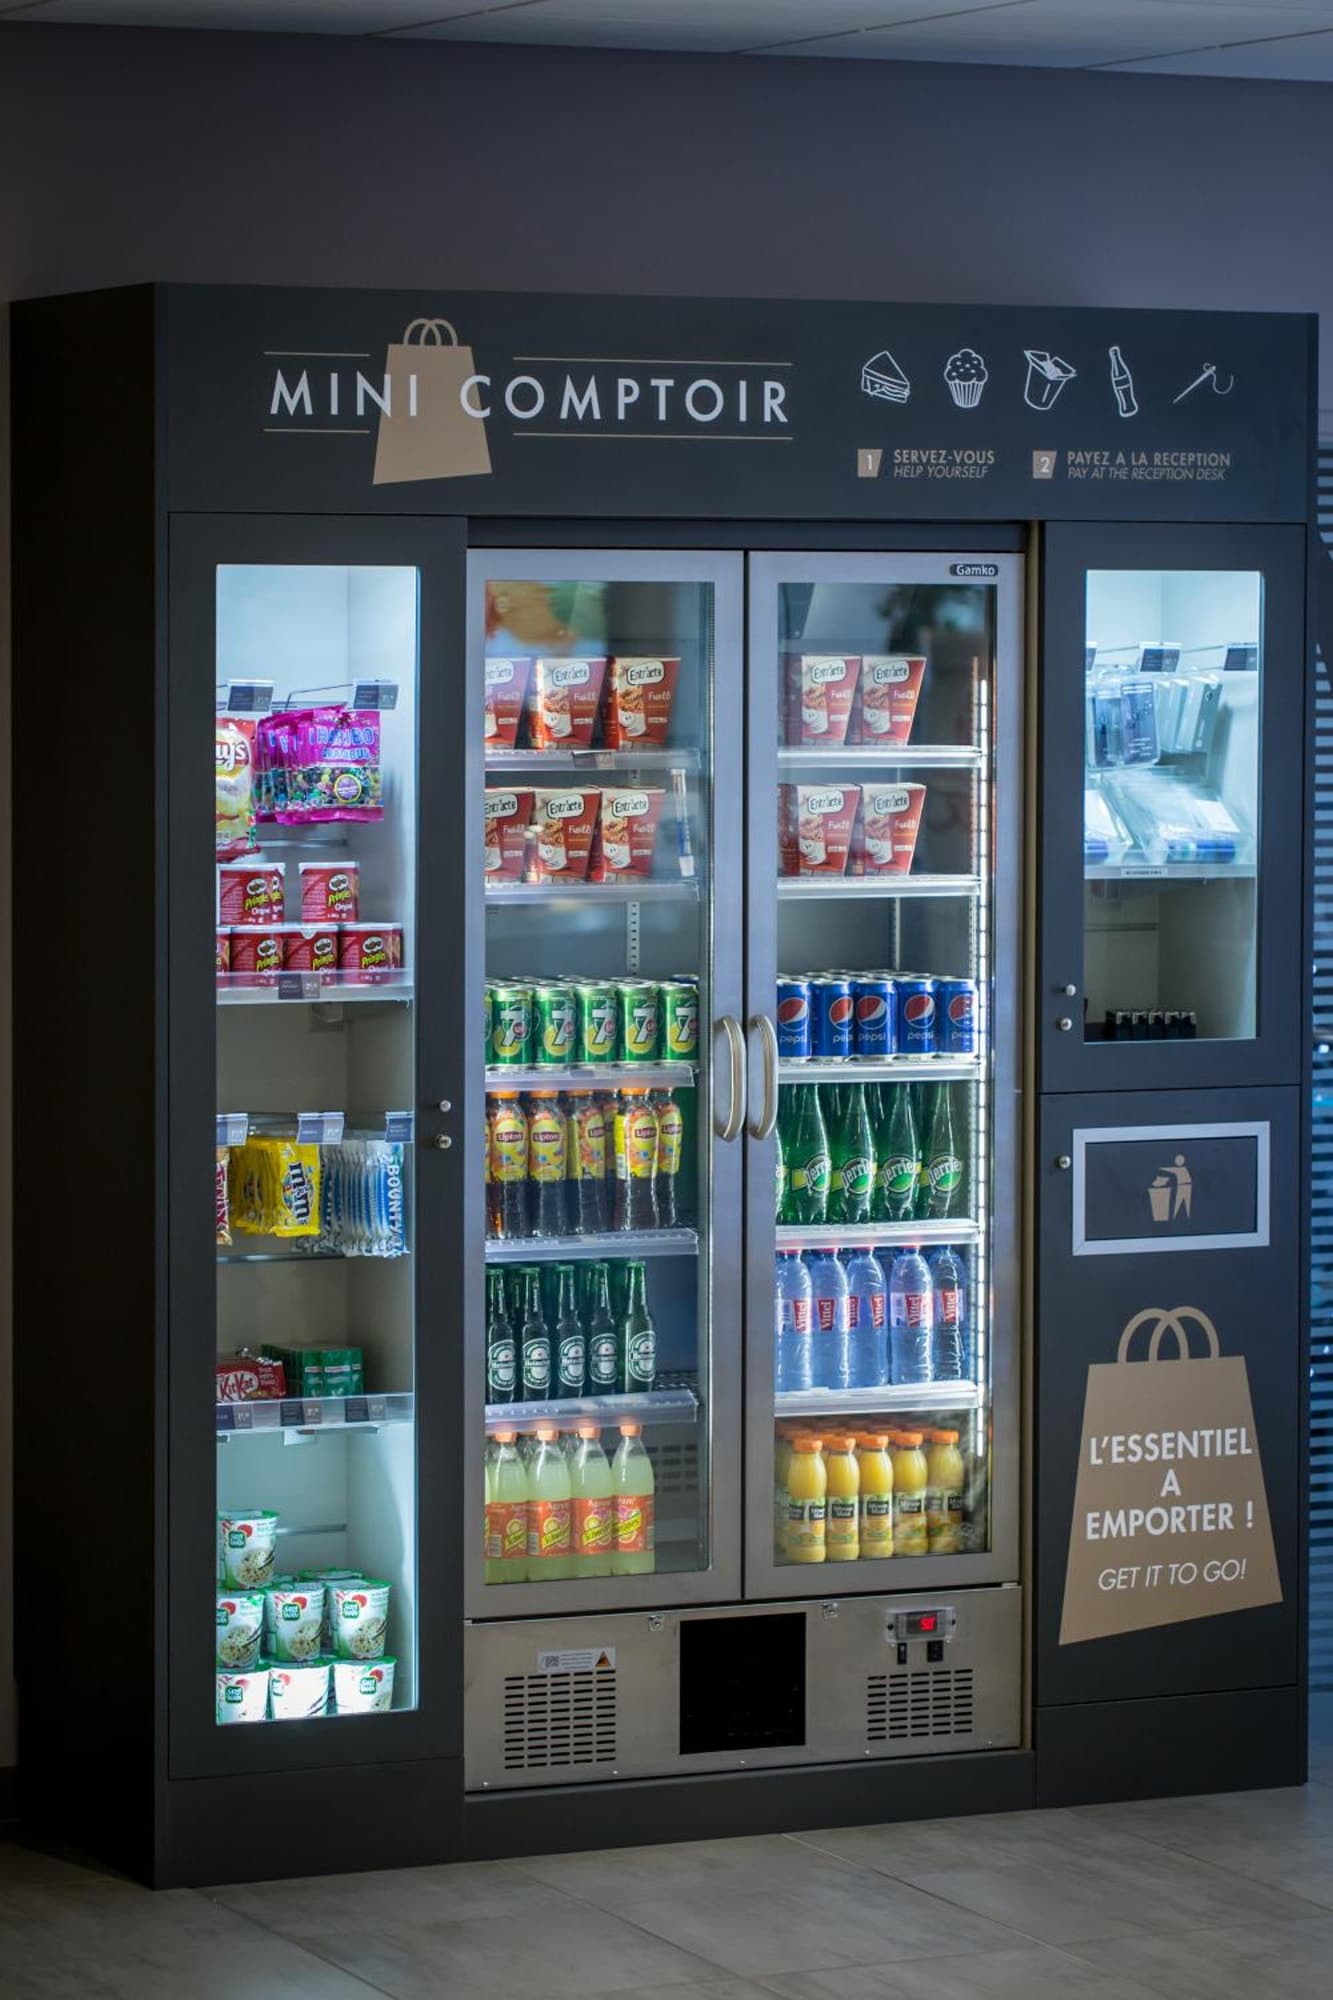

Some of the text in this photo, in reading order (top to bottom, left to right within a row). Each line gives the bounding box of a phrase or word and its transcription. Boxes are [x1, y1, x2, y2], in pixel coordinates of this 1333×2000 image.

[270, 369, 789, 423] MINI COMPTOIR
[893, 449, 995, 465] SERVEZ-VOUS
[1039, 456, 1051, 473] 2
[1067, 451, 1231, 467] PAYEZ A LA RECEPTION
[893, 465, 990, 479] HELP YOURSELF
[1067, 466, 1226, 481] PAY AT THE RECEPTION DESK
[956, 564, 996, 577] Gamko
[1089, 1427, 1253, 1466] L'ESSENTIEL
[1160, 1469, 1182, 1498] A
[1086, 1501, 1254, 1541] EMPORTER !
[1098, 1558, 1248, 1591] GET IT TO GO!
